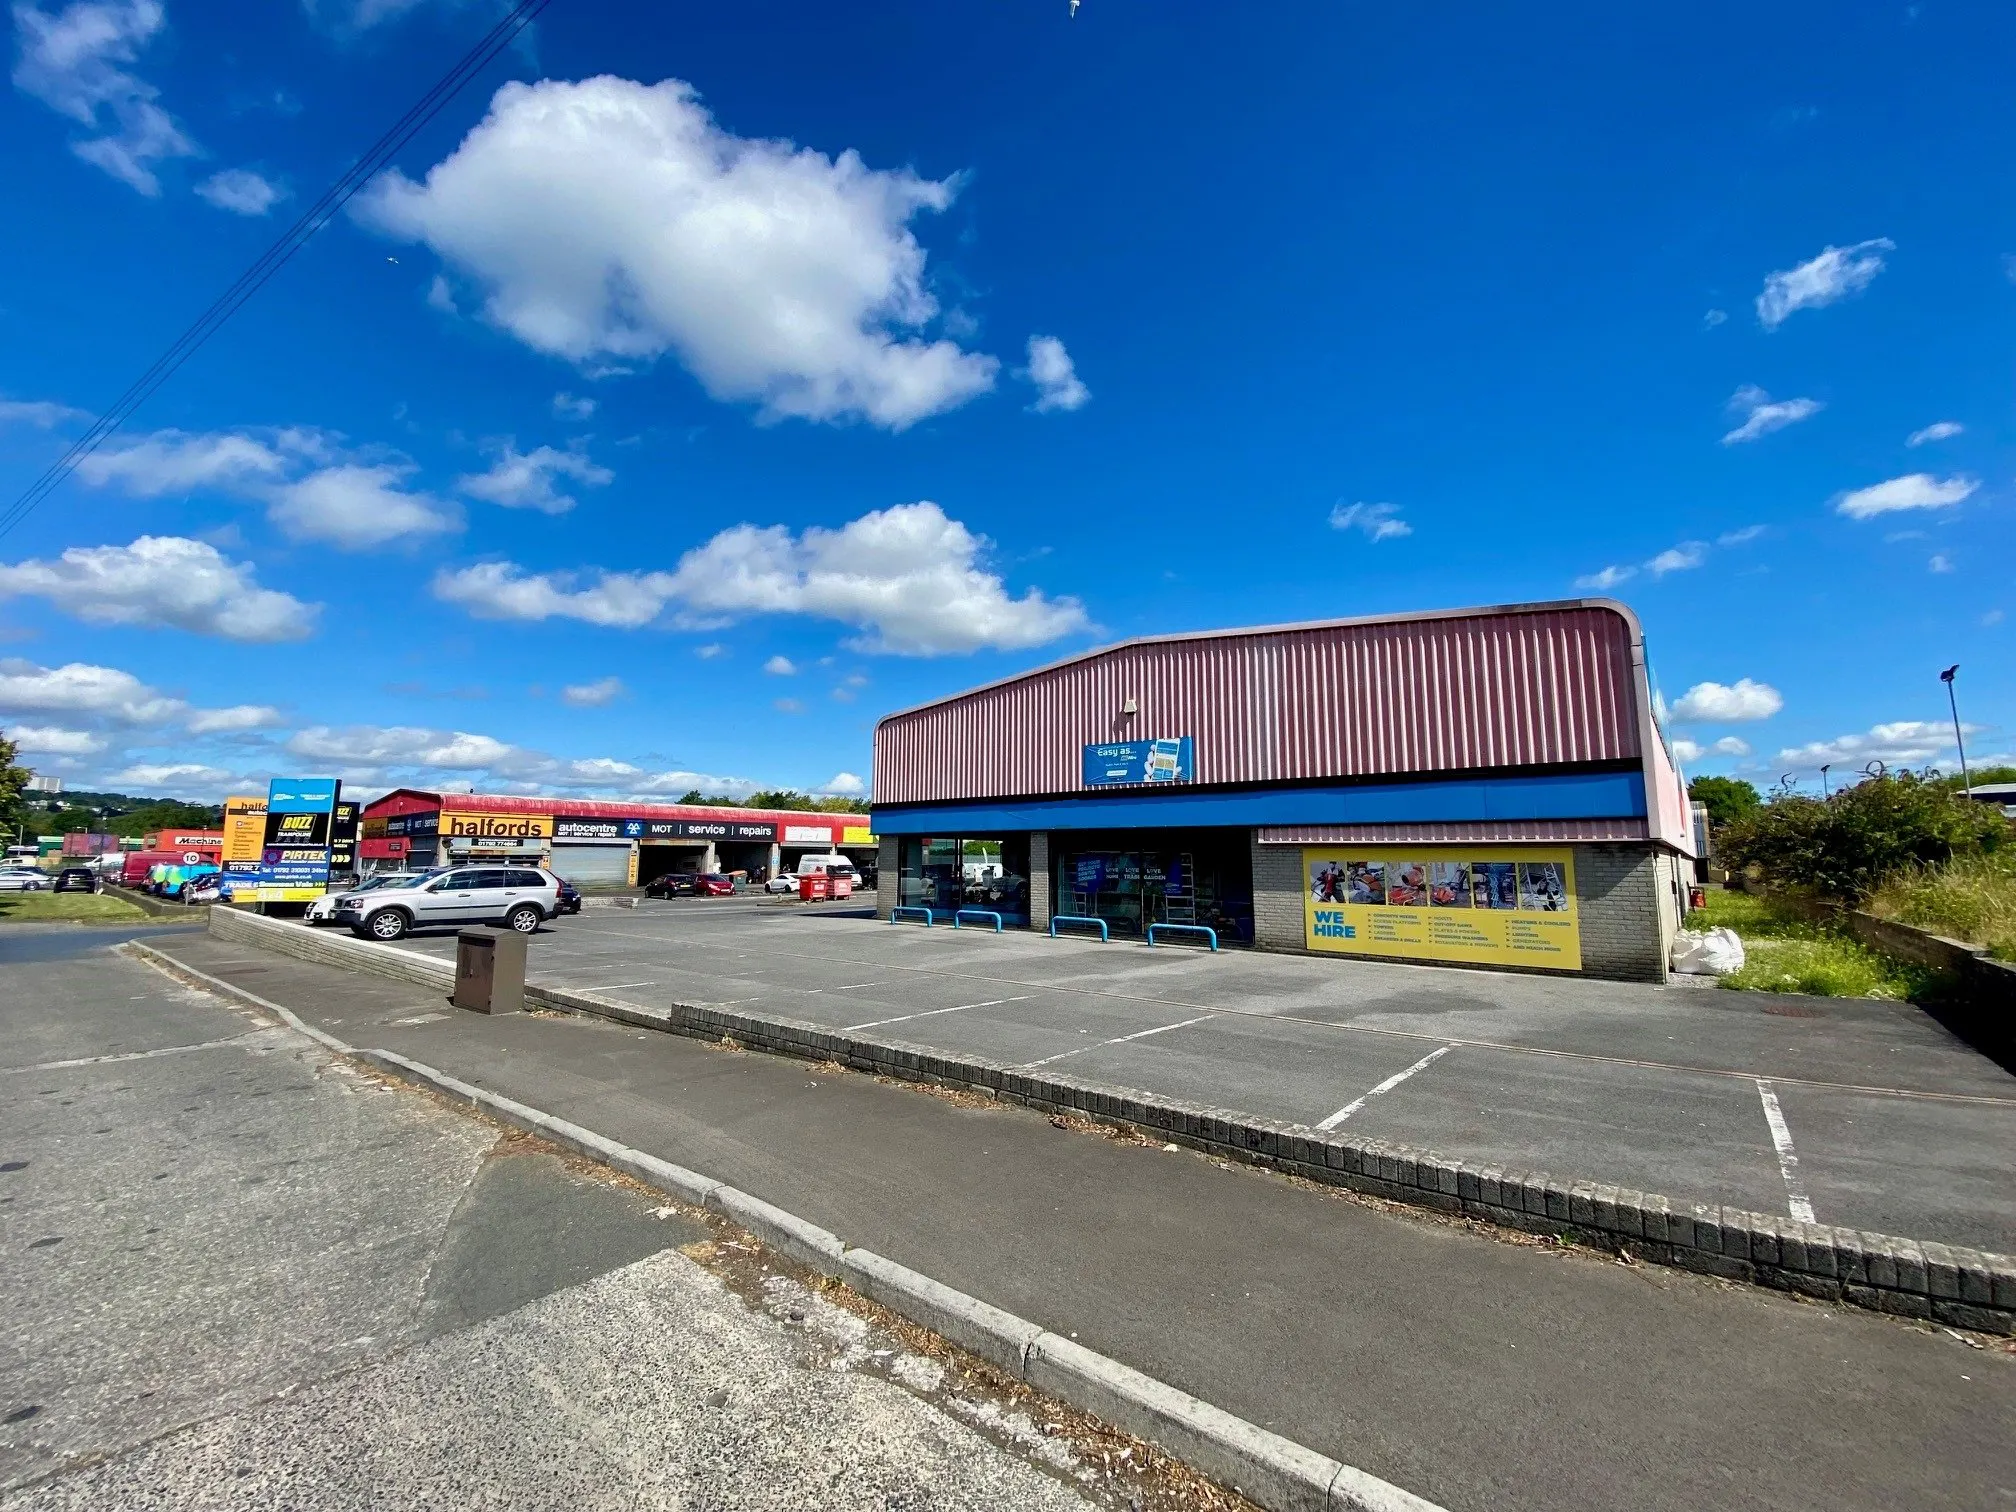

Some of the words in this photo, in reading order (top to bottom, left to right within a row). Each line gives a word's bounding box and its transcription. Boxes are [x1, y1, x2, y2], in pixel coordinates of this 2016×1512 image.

[1097, 748, 1118, 757] Easy
[282, 816, 314, 830] BUZZ
[450, 817, 542, 836] halfords
[558, 822, 618, 834] autocentre
[651, 824, 673, 834] MOT
[688, 823, 725, 835] service
[739, 825, 772, 837] repairs
[178, 837, 222, 845] Machine
[281, 850, 329, 860] PIRTEK
[1314, 910, 1344, 924] WE
[1313, 924, 1356, 938] HIRE
